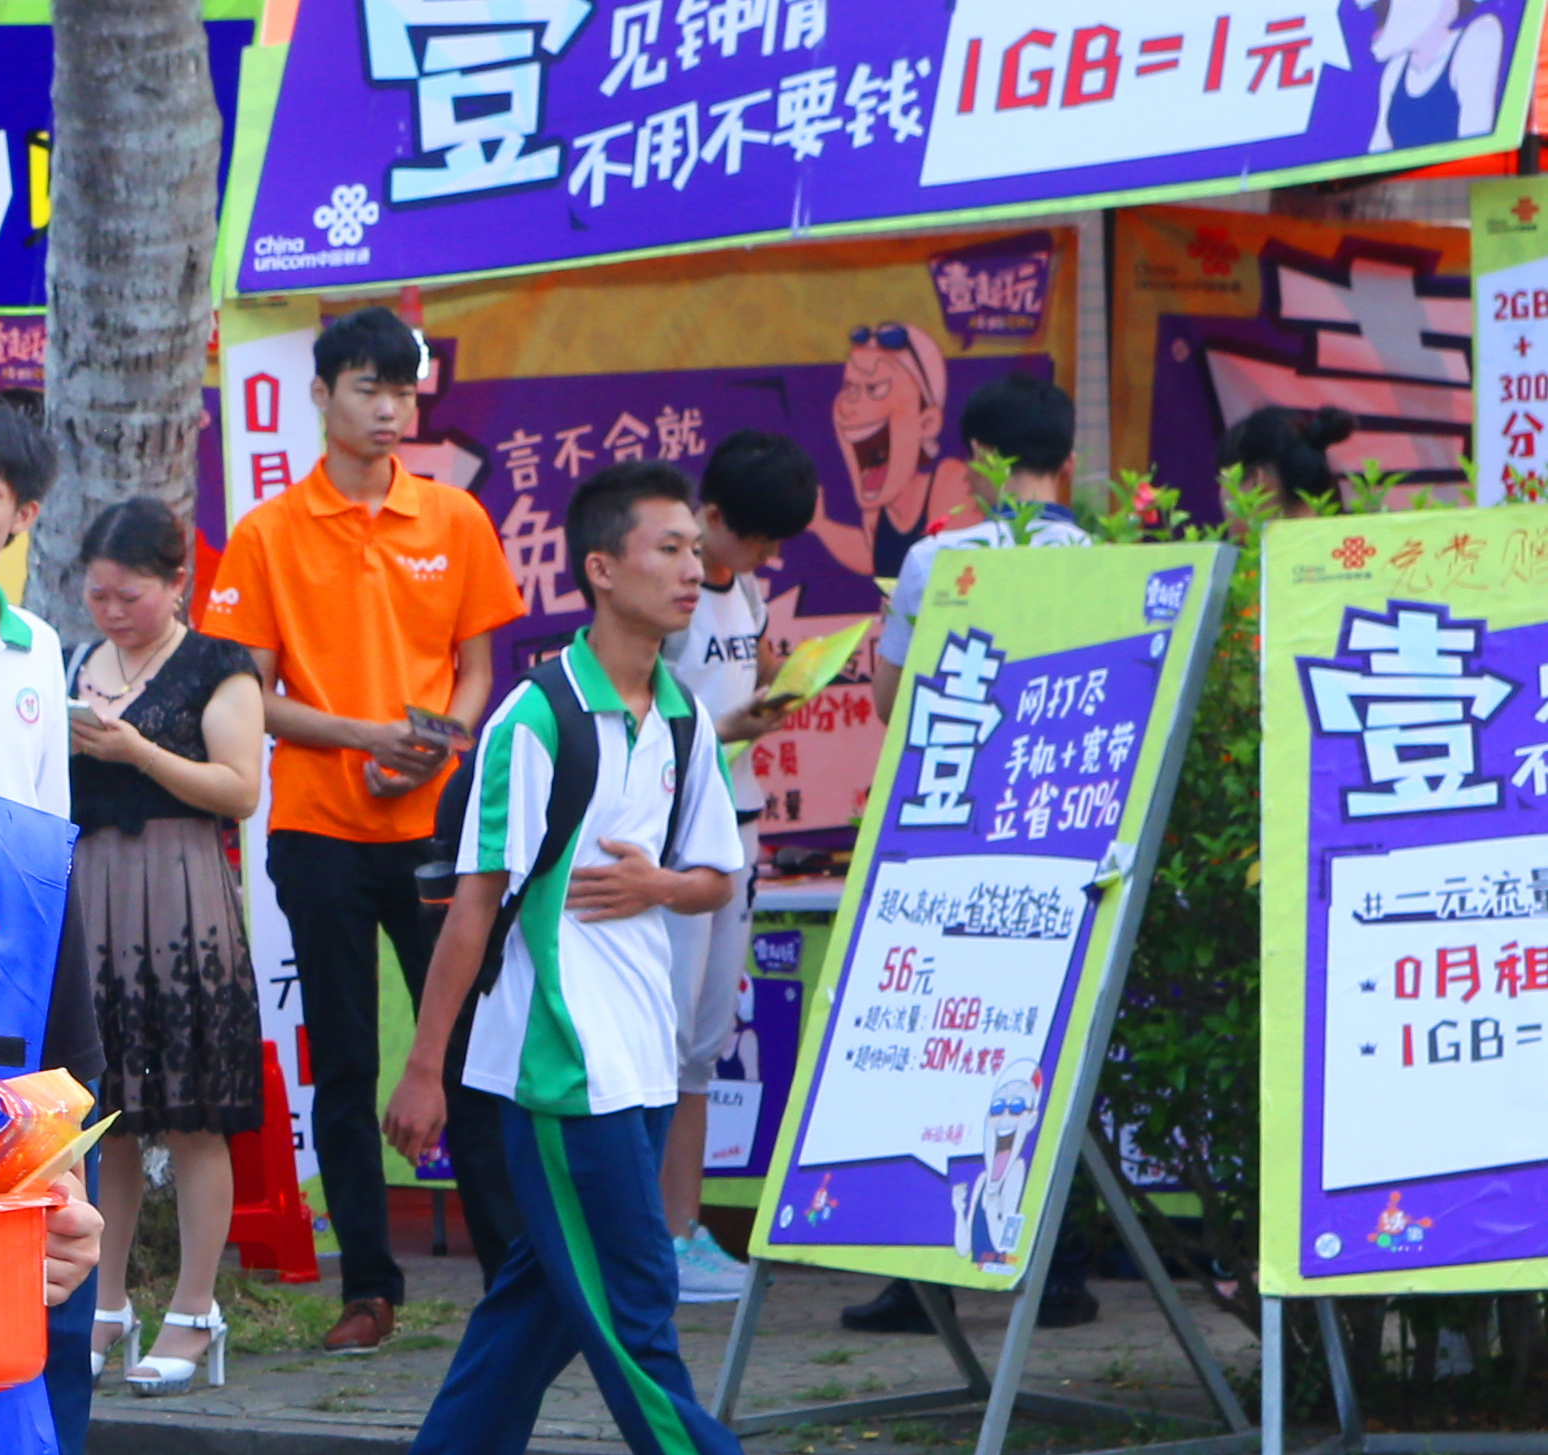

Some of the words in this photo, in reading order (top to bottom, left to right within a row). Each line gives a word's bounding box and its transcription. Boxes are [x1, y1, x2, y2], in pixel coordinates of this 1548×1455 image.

[957, 16, 1315, 115] 1GB=1元
[568, 58, 934, 207] 不用不要钱
[255, 236, 304, 255] China
[1015, 667, 1109, 726] 网打尽
[1309, 610, 1514, 817] 壹
[899, 637, 1002, 826] 壹
[1004, 720, 1136, 786] 手机+宽带
[986, 779, 1120, 842] 立省50%
[877, 945, 936, 996] 56元
